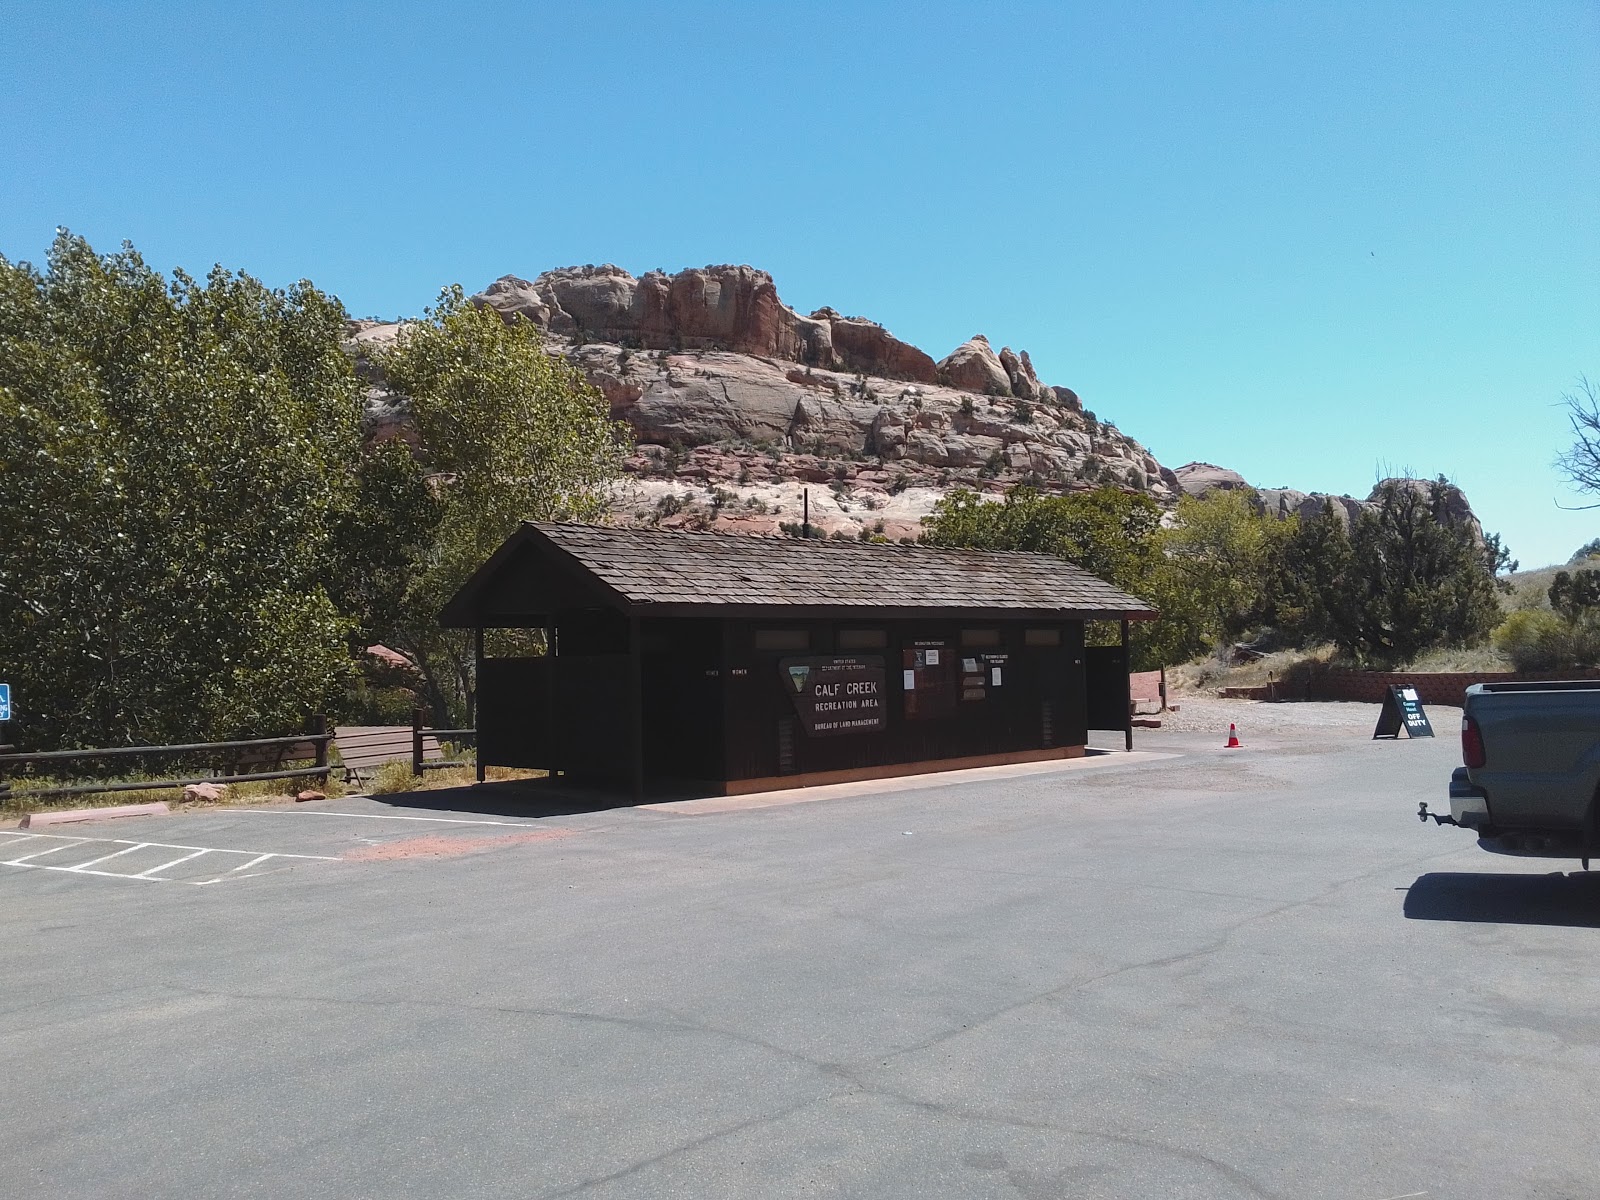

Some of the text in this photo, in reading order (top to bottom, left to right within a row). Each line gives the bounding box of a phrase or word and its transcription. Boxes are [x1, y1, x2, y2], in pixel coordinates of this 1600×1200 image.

[815, 681, 877, 697] CALF CREEK
[815, 698, 879, 712] RECREATION AREA
[815, 717, 879, 730] BUREAU OF LAND MANAGEMENT
